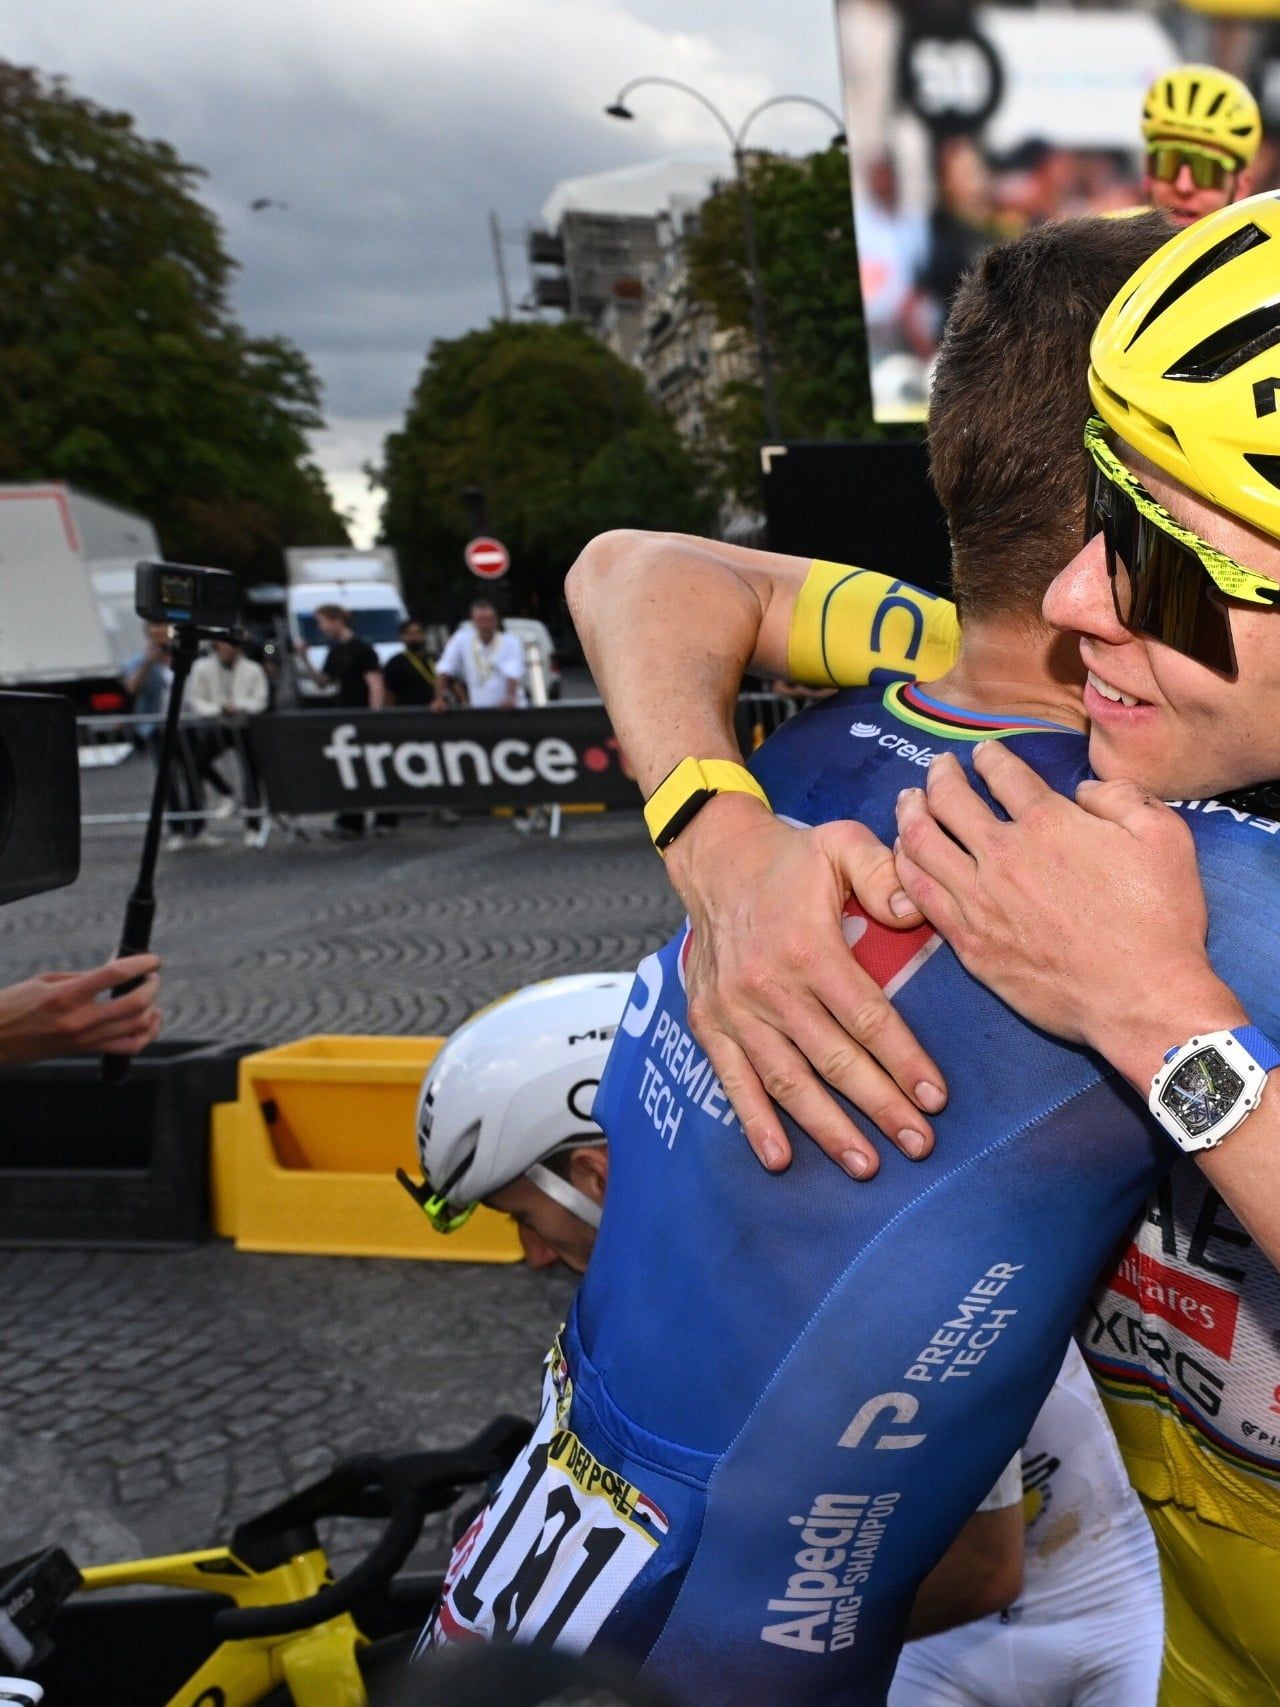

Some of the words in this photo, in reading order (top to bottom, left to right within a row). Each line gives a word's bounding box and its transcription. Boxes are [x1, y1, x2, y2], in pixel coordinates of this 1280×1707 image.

[324, 724, 577, 790] france
[878, 734, 935, 767] crela
[638, 1057, 683, 1150] TECH
[903, 1262, 1025, 1382] PREMIER
[1117, 1256, 1215, 1331] irates
[940, 1308, 1018, 1382] TECH
[570, 1437, 592, 1485] DER
[760, 1493, 871, 1653] Alpecin
[843, 1492, 901, 1587] SHAMPOO
[829, 1596, 862, 1652] DMG
